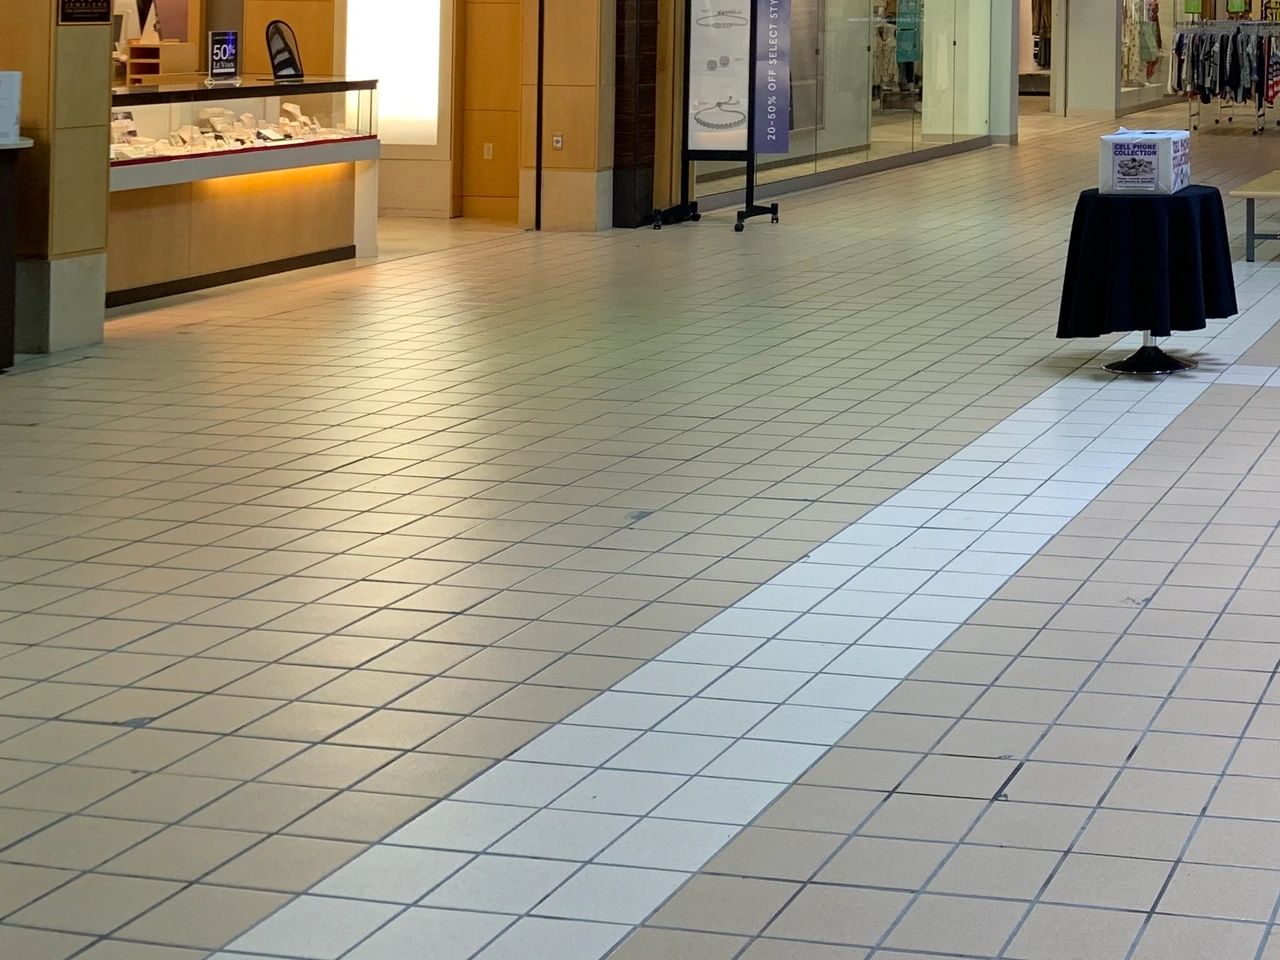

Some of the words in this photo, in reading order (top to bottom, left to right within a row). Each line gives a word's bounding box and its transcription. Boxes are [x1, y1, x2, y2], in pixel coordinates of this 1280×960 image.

[768, 23, 778, 65] SELECT
[768, 69, 777, 91] OFF
[767, 95, 777, 140] 20-50%
